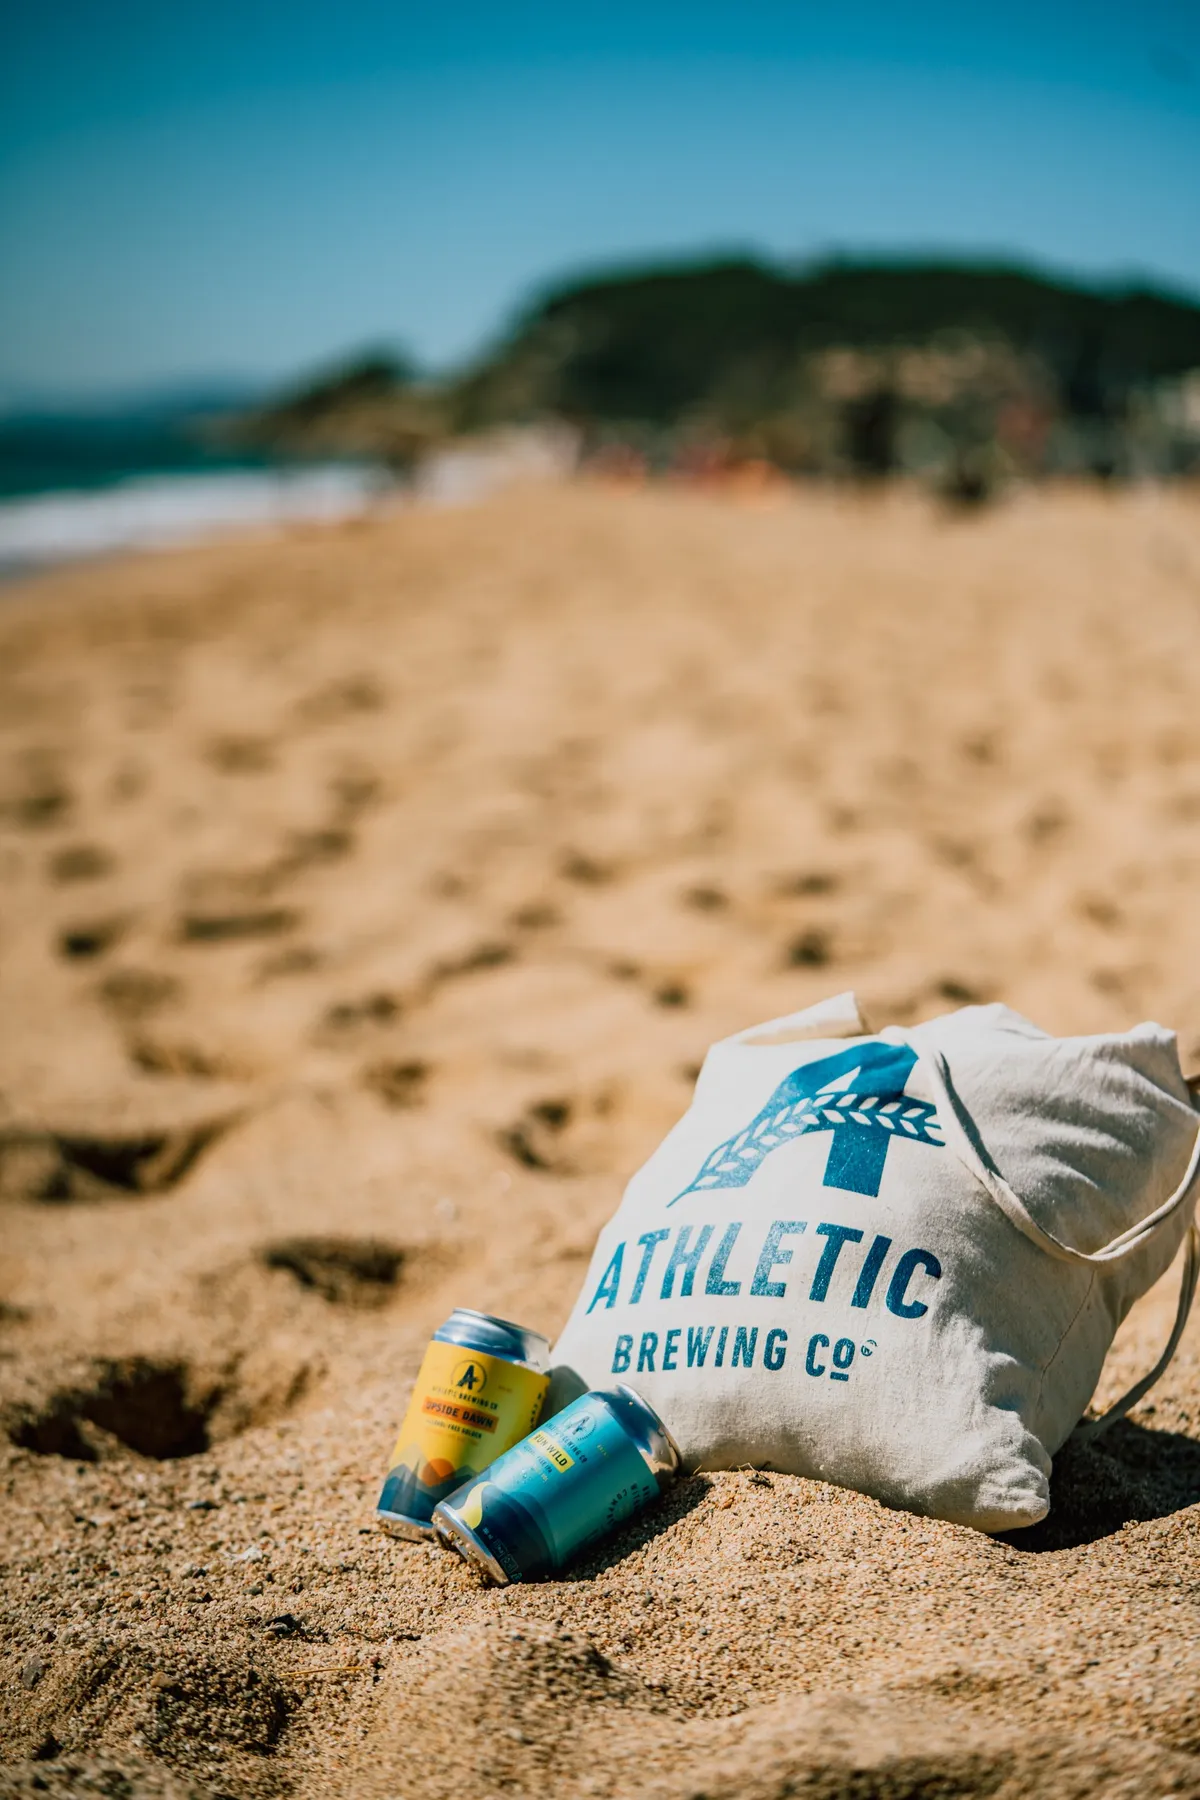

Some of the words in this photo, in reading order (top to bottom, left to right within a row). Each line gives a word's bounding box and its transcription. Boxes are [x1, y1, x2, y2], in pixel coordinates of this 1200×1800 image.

[586, 1220, 942, 1319] ATHLETIC
[611, 1326, 788, 1374] BREWING
[426, 1400, 459, 1417] UPSIDE
[462, 1411, 493, 1428] DAWN
[533, 1432, 548, 1447] RUN
[545, 1444, 568, 1467] WILD
